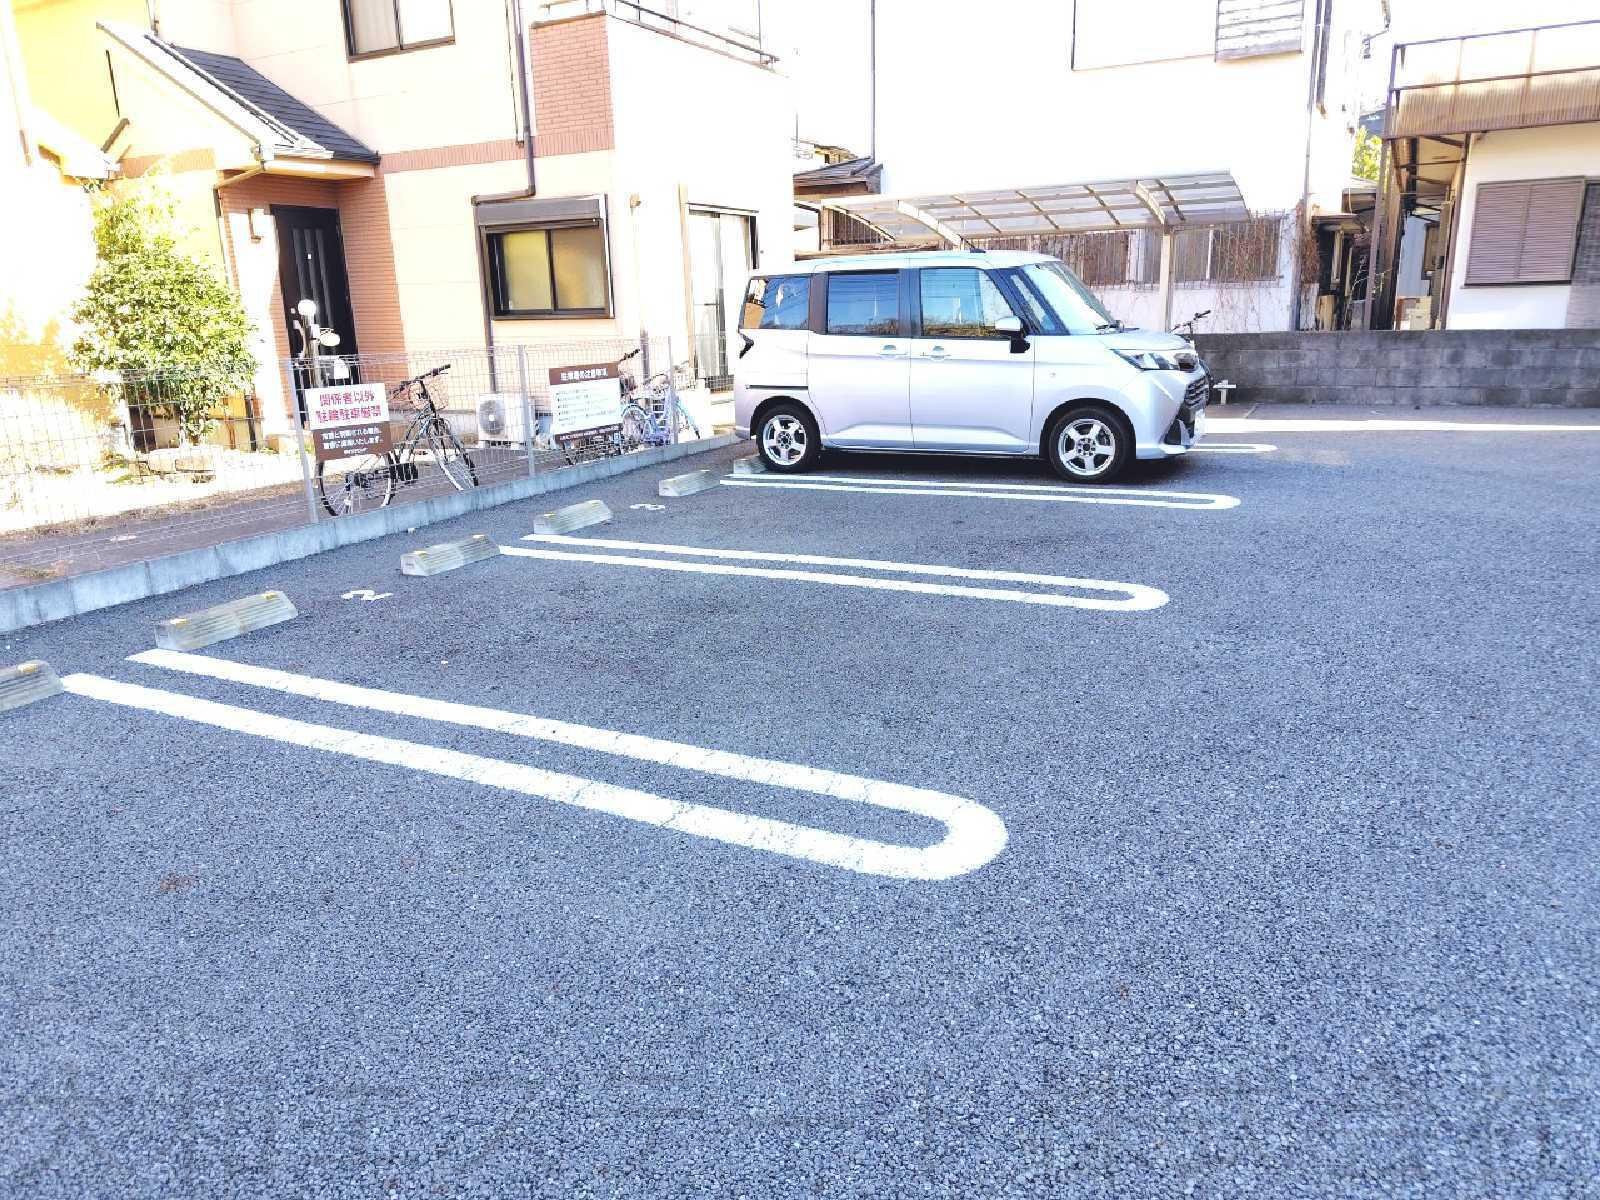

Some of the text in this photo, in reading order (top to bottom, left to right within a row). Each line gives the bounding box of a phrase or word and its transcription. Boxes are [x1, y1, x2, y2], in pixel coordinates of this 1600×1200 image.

[319, 389, 375, 406] 関係者以外
[341, 590, 394, 601] 2
